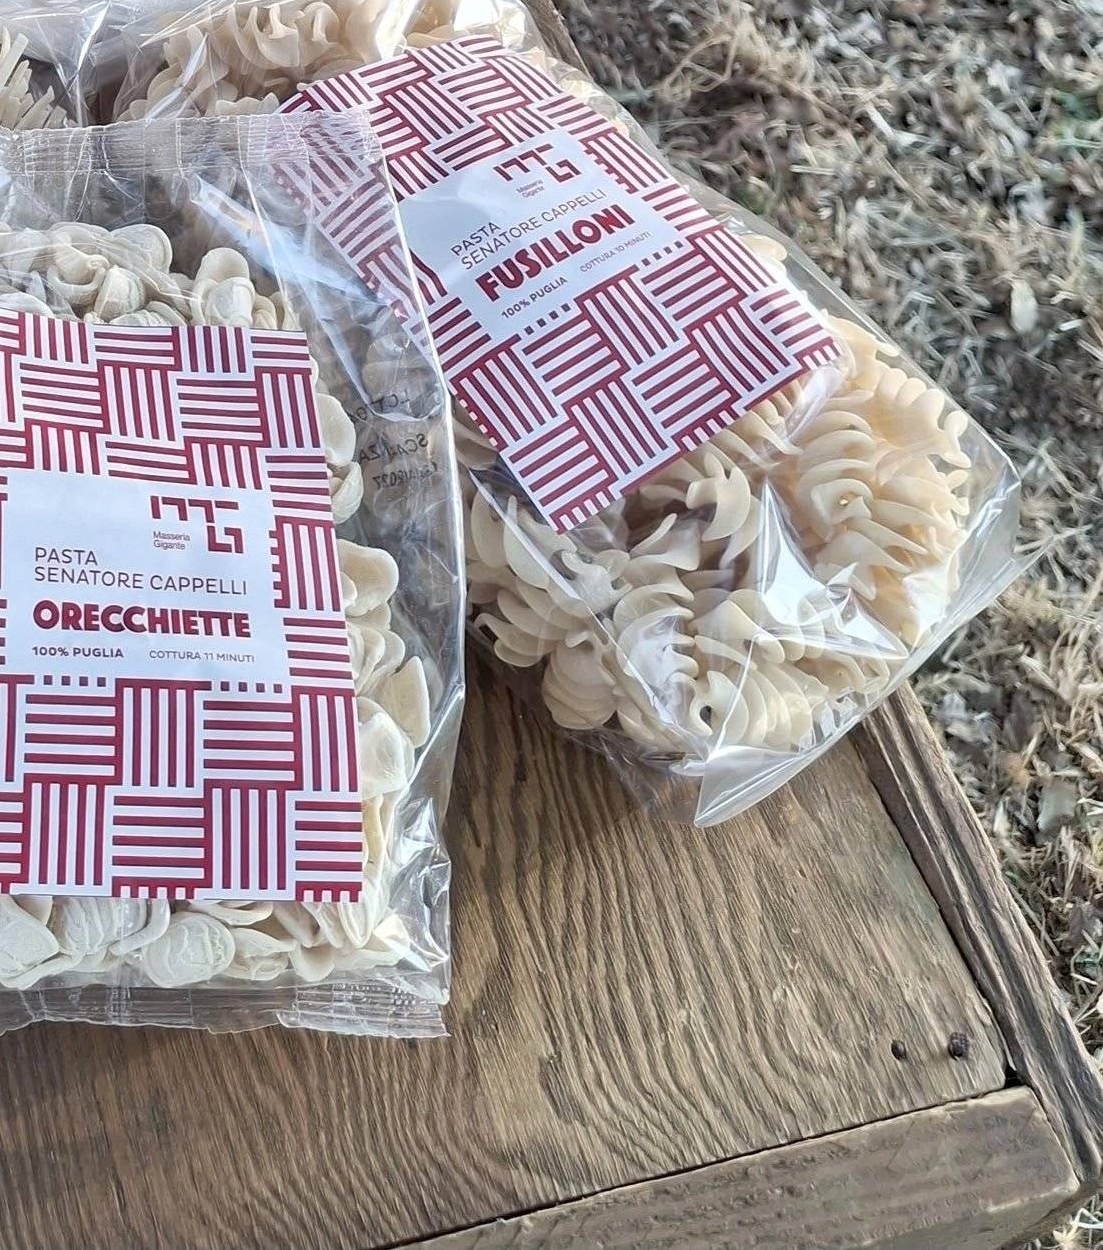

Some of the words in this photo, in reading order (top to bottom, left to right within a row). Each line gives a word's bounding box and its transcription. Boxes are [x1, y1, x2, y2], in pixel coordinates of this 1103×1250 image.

[450, 221, 502, 257] PASTA
[461, 217, 543, 271] SENATORE
[541, 188, 607, 224] CAPPELLI
[475, 204, 635, 302] FUSILLONI
[579, 248, 616, 273] COTTURA
[624, 231, 652, 250] MINUTI
[501, 297, 530, 320] 100%
[529, 276, 568, 303] PUGLIA
[153, 531, 190, 542] Masseria
[153, 539, 186, 551] Gigante
[35, 547, 98, 565] PASTA
[34, 566, 144, 589] SENATORE
[150, 575, 247, 595] CAPPELLI
[33, 600, 251, 638] ORECCHIETTE
[32, 646, 69, 657] 100%
[73, 646, 124, 658] PUGLIA
[149, 650, 202, 660] COTTURA
[215, 653, 255, 663] MINUTI
